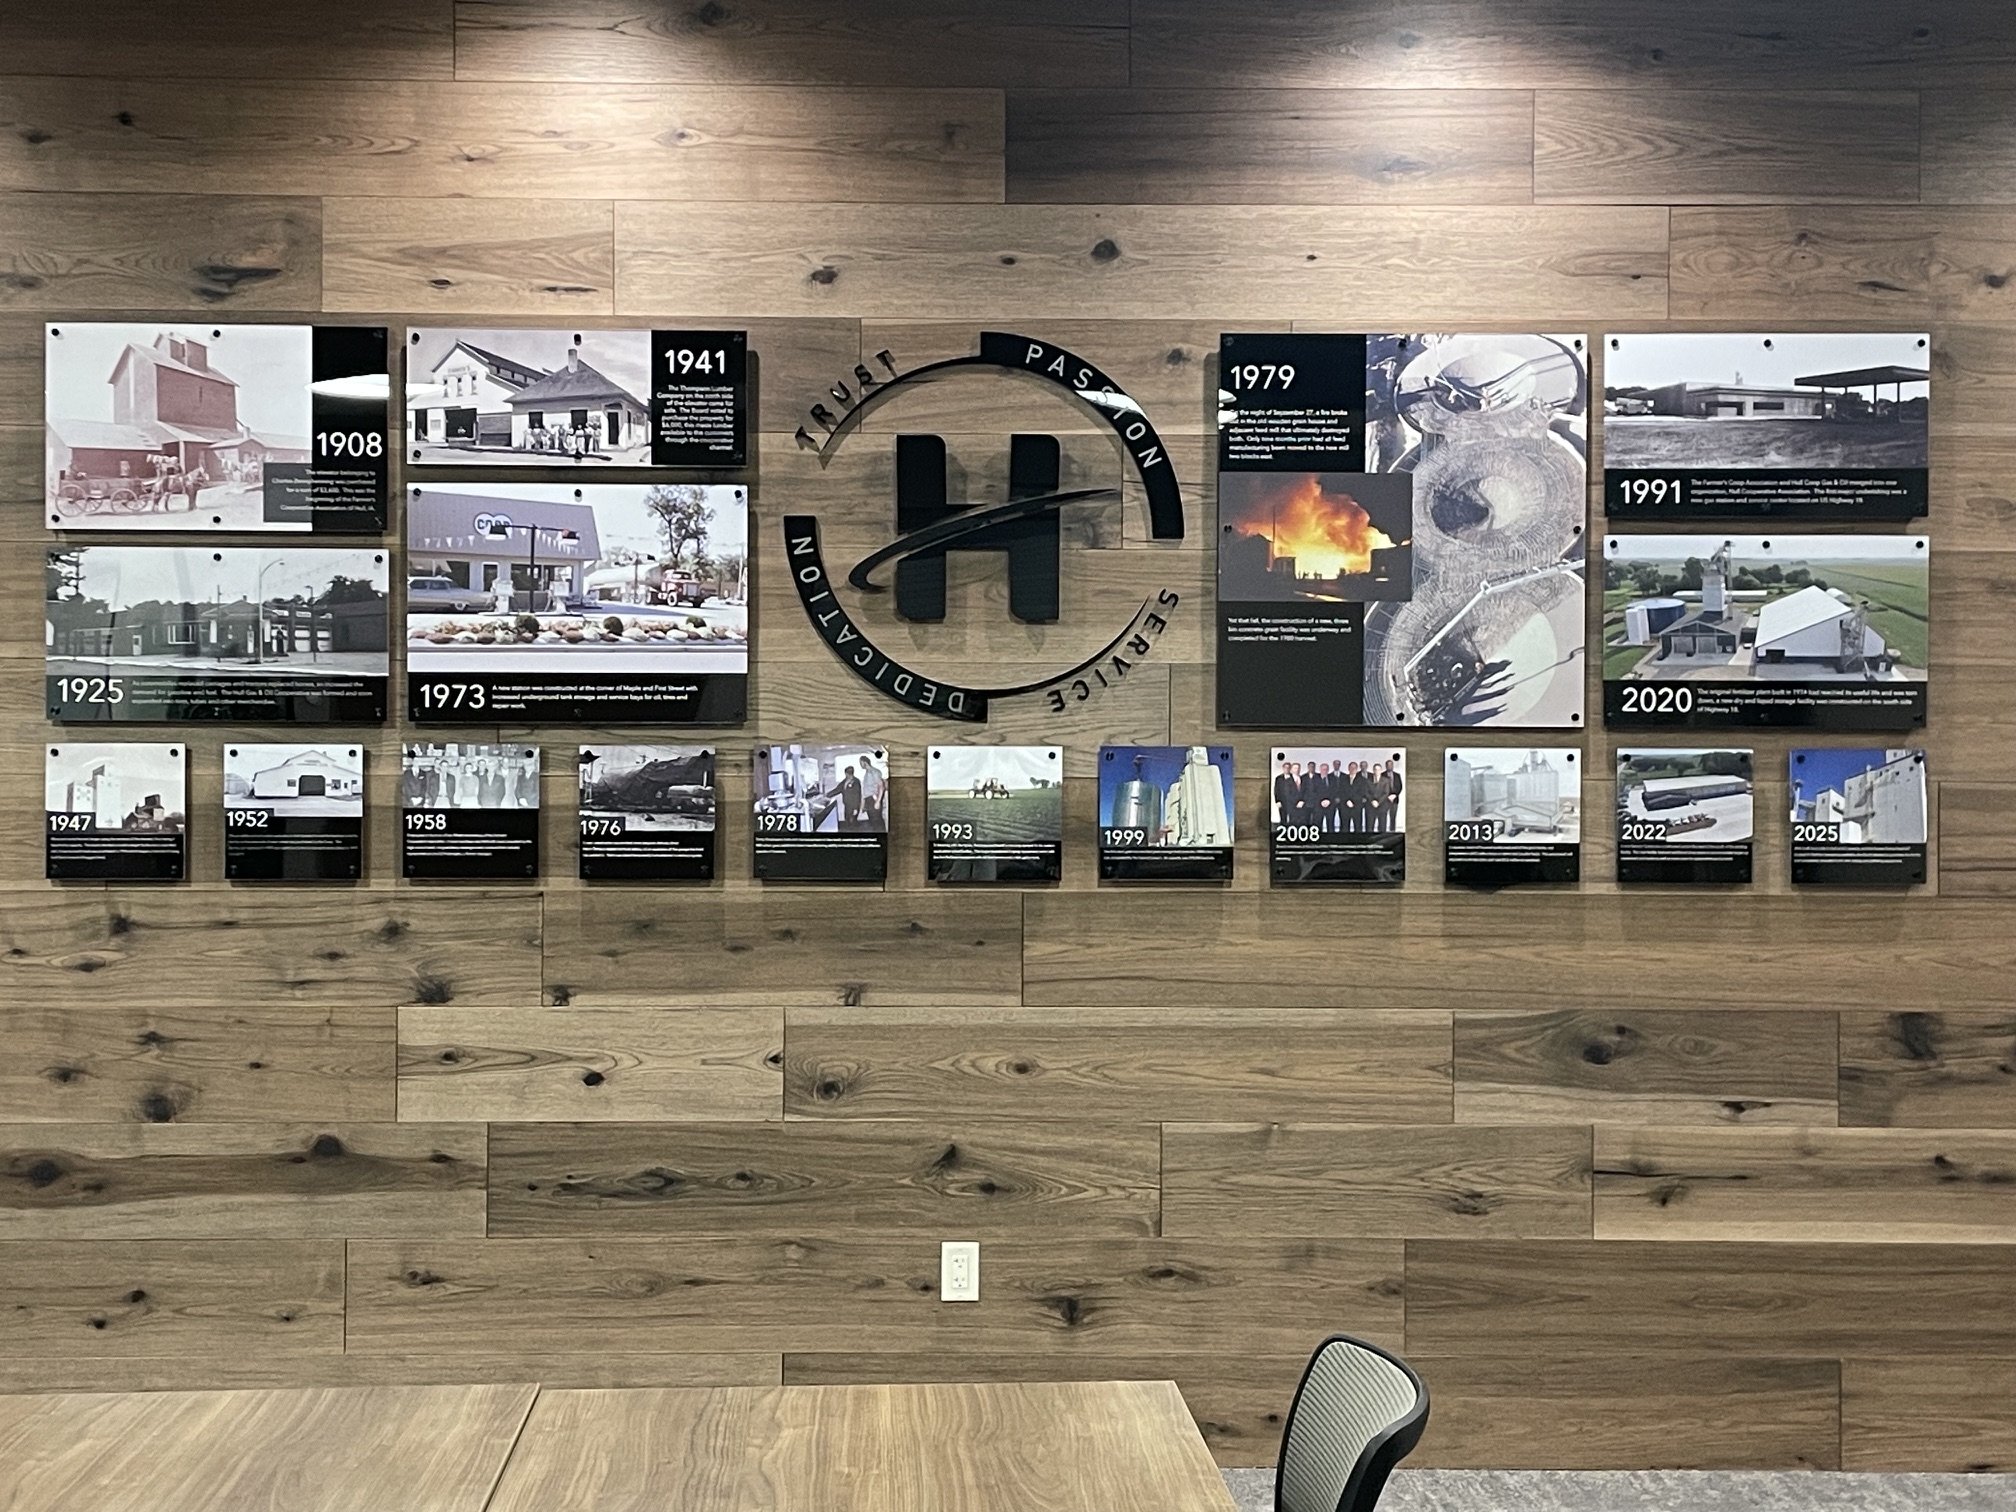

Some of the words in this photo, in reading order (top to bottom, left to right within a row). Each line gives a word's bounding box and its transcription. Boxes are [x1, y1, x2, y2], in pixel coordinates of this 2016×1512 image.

[665, 349, 725, 374] 1941
[1231, 365, 1295, 389] 1979
[795, 349, 897, 452] TRUST
[1025, 343, 1163, 469] PASSION
[317, 432, 383, 457] 1908
[1620, 479, 1680, 504] 1991
[791, 536, 965, 713] DEDICATION
[1046, 588, 1179, 713] SERVICE
[57, 678, 124, 704] 1925
[420, 684, 485, 709] 1973
[1621, 687, 1693, 712] 2020
[49, 815, 92, 831] 1947
[226, 811, 269, 828] 1952
[405, 814, 447, 830] 1958
[580, 820, 621, 836] 1976
[757, 815, 797, 832] 1978
[932, 824, 973, 840] 1993
[1104, 830, 1145, 846] 1999
[1276, 826, 1320, 842] 2008
[1448, 825, 1493, 841] 2013
[1621, 824, 1667, 841] 2022
[1793, 825, 1839, 842] 2025
